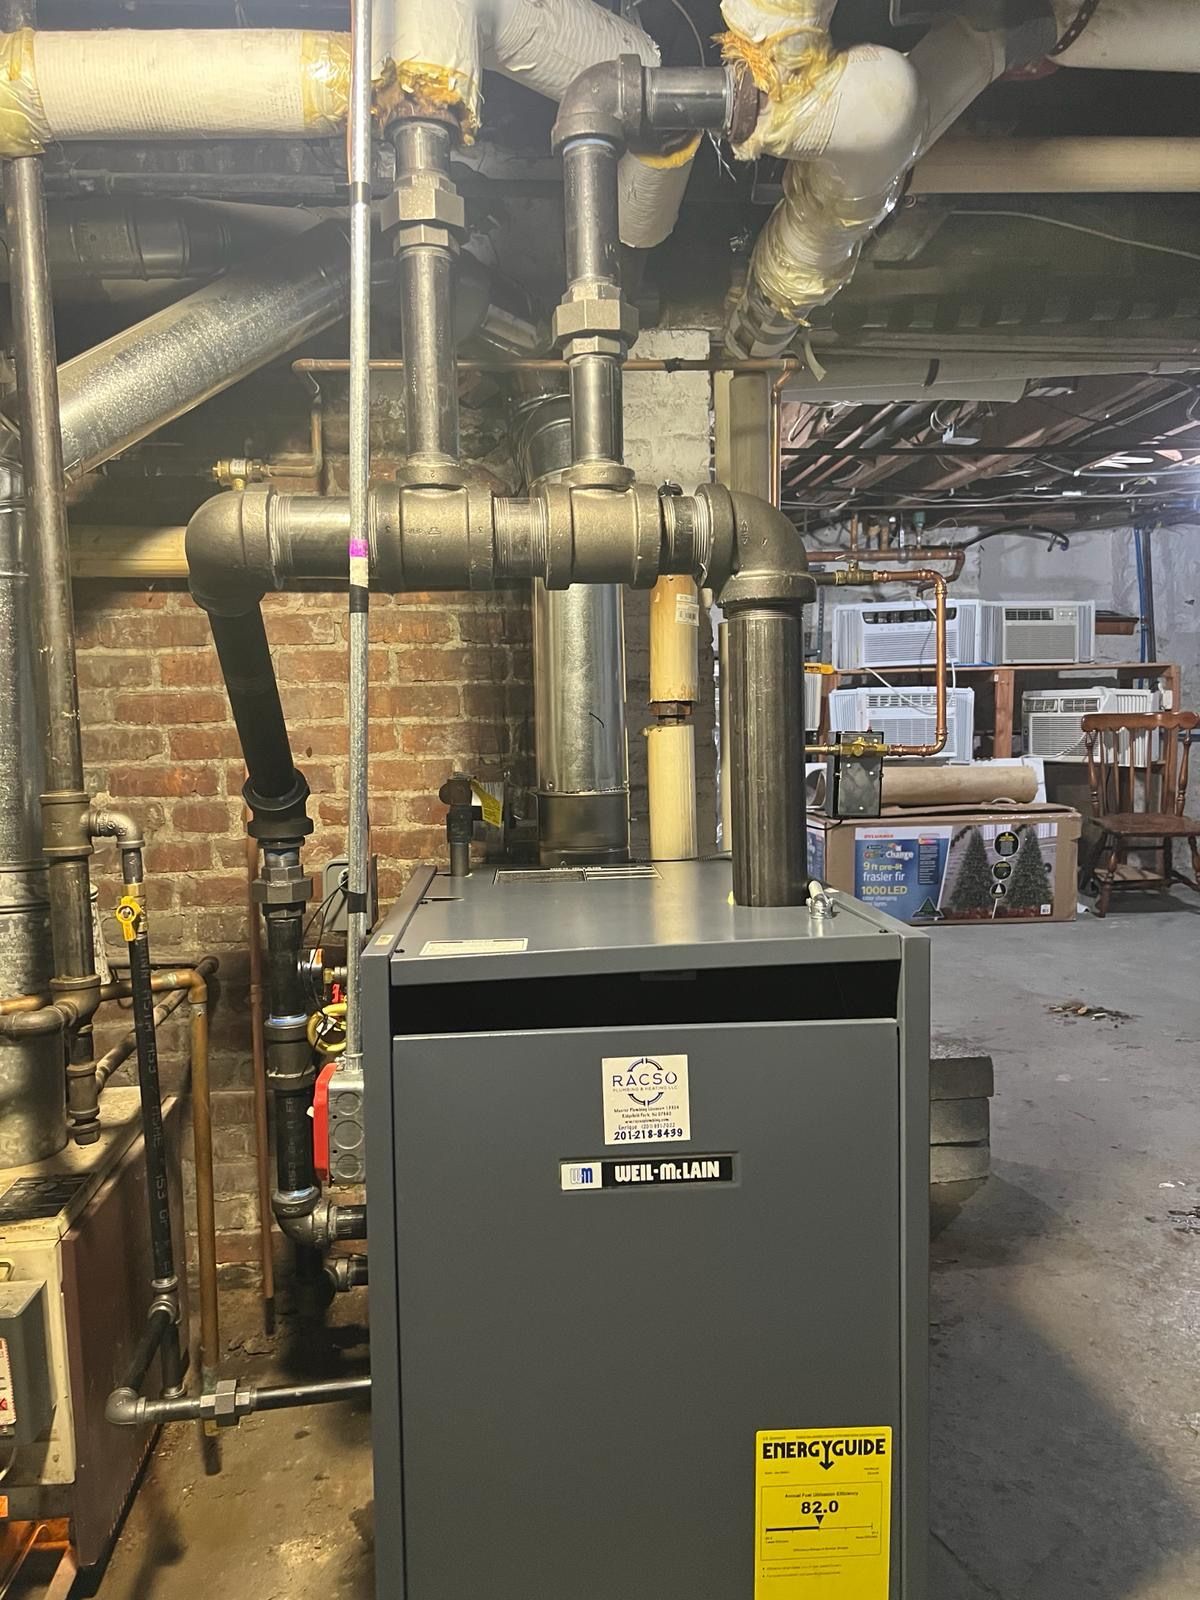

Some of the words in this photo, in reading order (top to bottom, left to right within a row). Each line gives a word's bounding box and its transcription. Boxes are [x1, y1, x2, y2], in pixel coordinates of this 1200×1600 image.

[886, 850, 914, 860] Change
[863, 861, 871, 871] 9
[895, 871, 905, 881] fir
[862, 886, 887, 895] 1000
[888, 885, 908, 895] LED
[613, 1072, 677, 1087] RACSO
[763, 1438, 885, 1460] ENERGYGUIDE
[801, 1500, 839, 1514] 82.0
